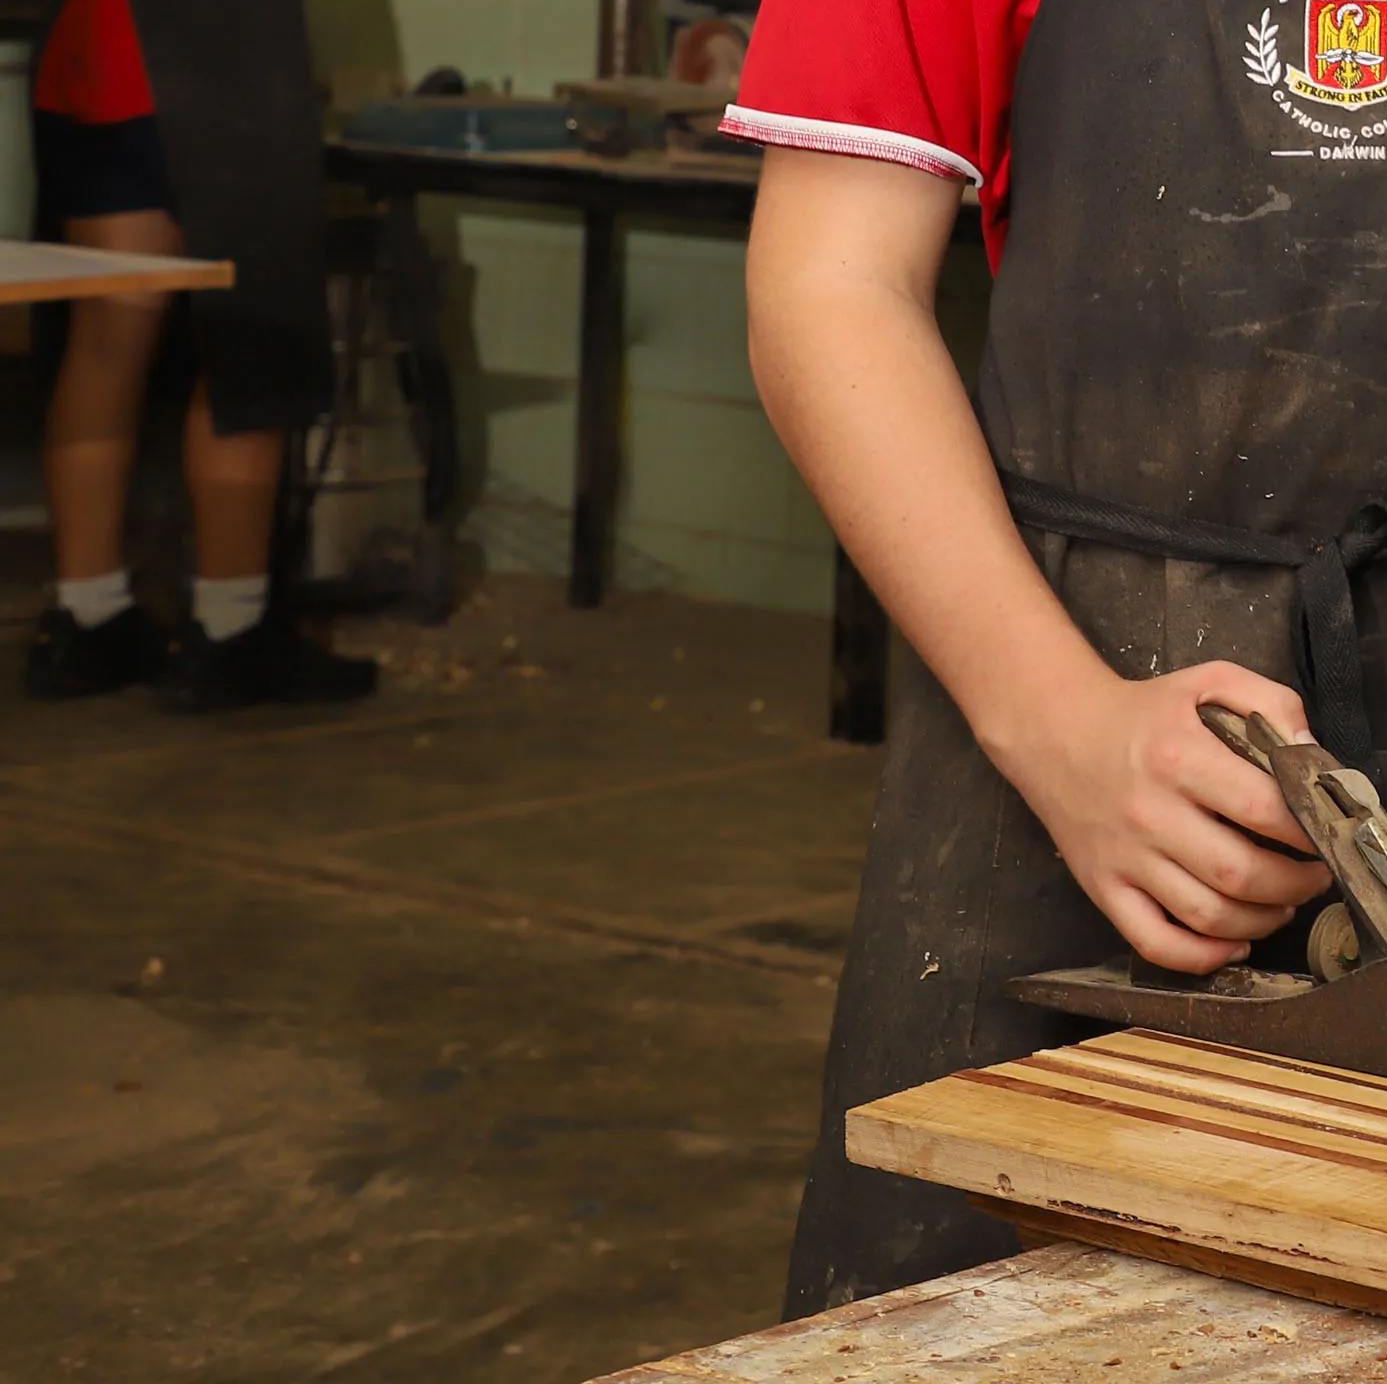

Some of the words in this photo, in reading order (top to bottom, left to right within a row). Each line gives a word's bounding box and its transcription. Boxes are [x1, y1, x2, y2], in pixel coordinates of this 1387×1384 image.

[1295, 81, 1345, 102] STRONG
[1349, 93, 1362, 102] IN
[1272, 90, 1353, 139] CATHOLIC
[1319, 146, 1386, 160] DARWIN
